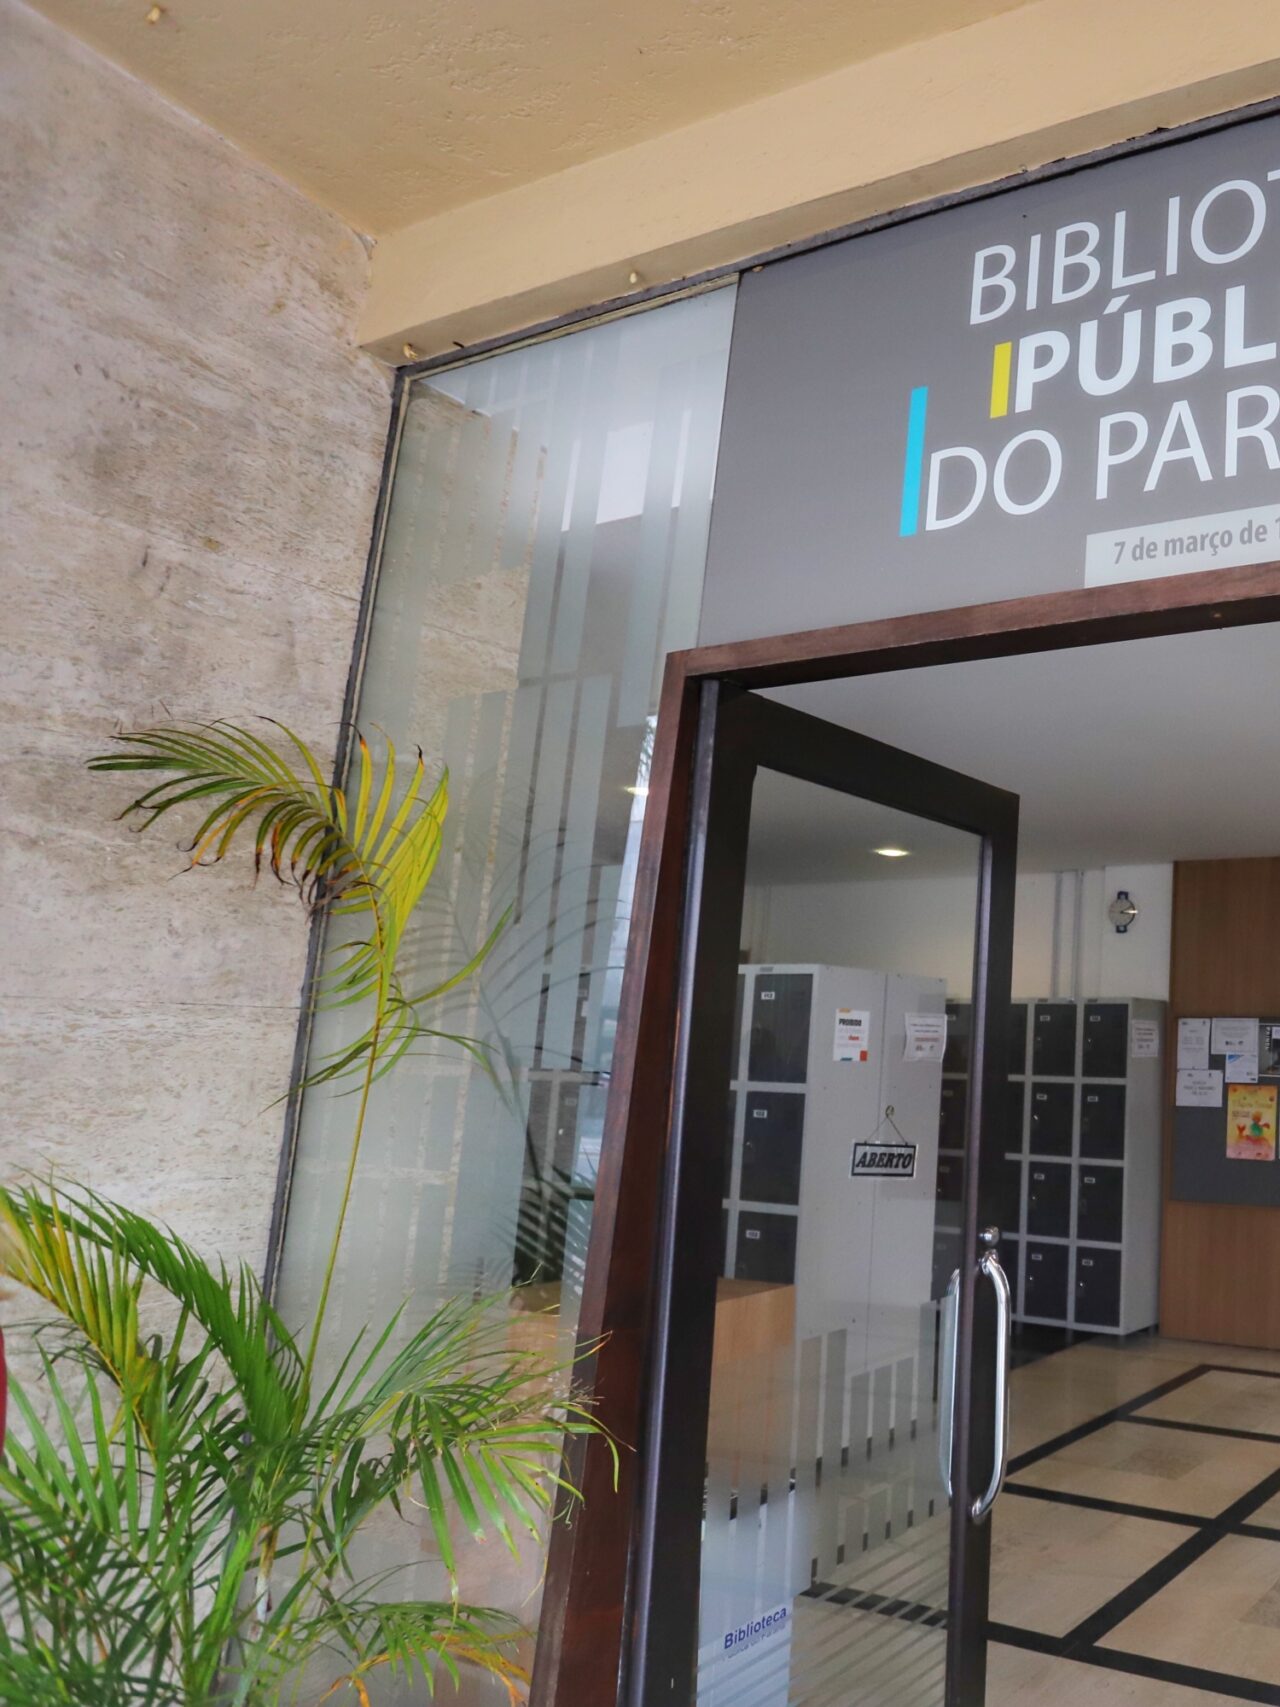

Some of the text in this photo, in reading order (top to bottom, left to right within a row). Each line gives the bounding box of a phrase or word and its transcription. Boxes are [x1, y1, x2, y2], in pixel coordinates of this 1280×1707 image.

[925, 429, 1063, 531] DO
[1113, 541, 1126, 564] 7
[1131, 536, 1158, 562] de
[1163, 527, 1233, 556] março
[1239, 519, 1268, 545] de
[856, 1151, 913, 1169] ABERTO
[724, 1607, 787, 1650] Biblioteca
